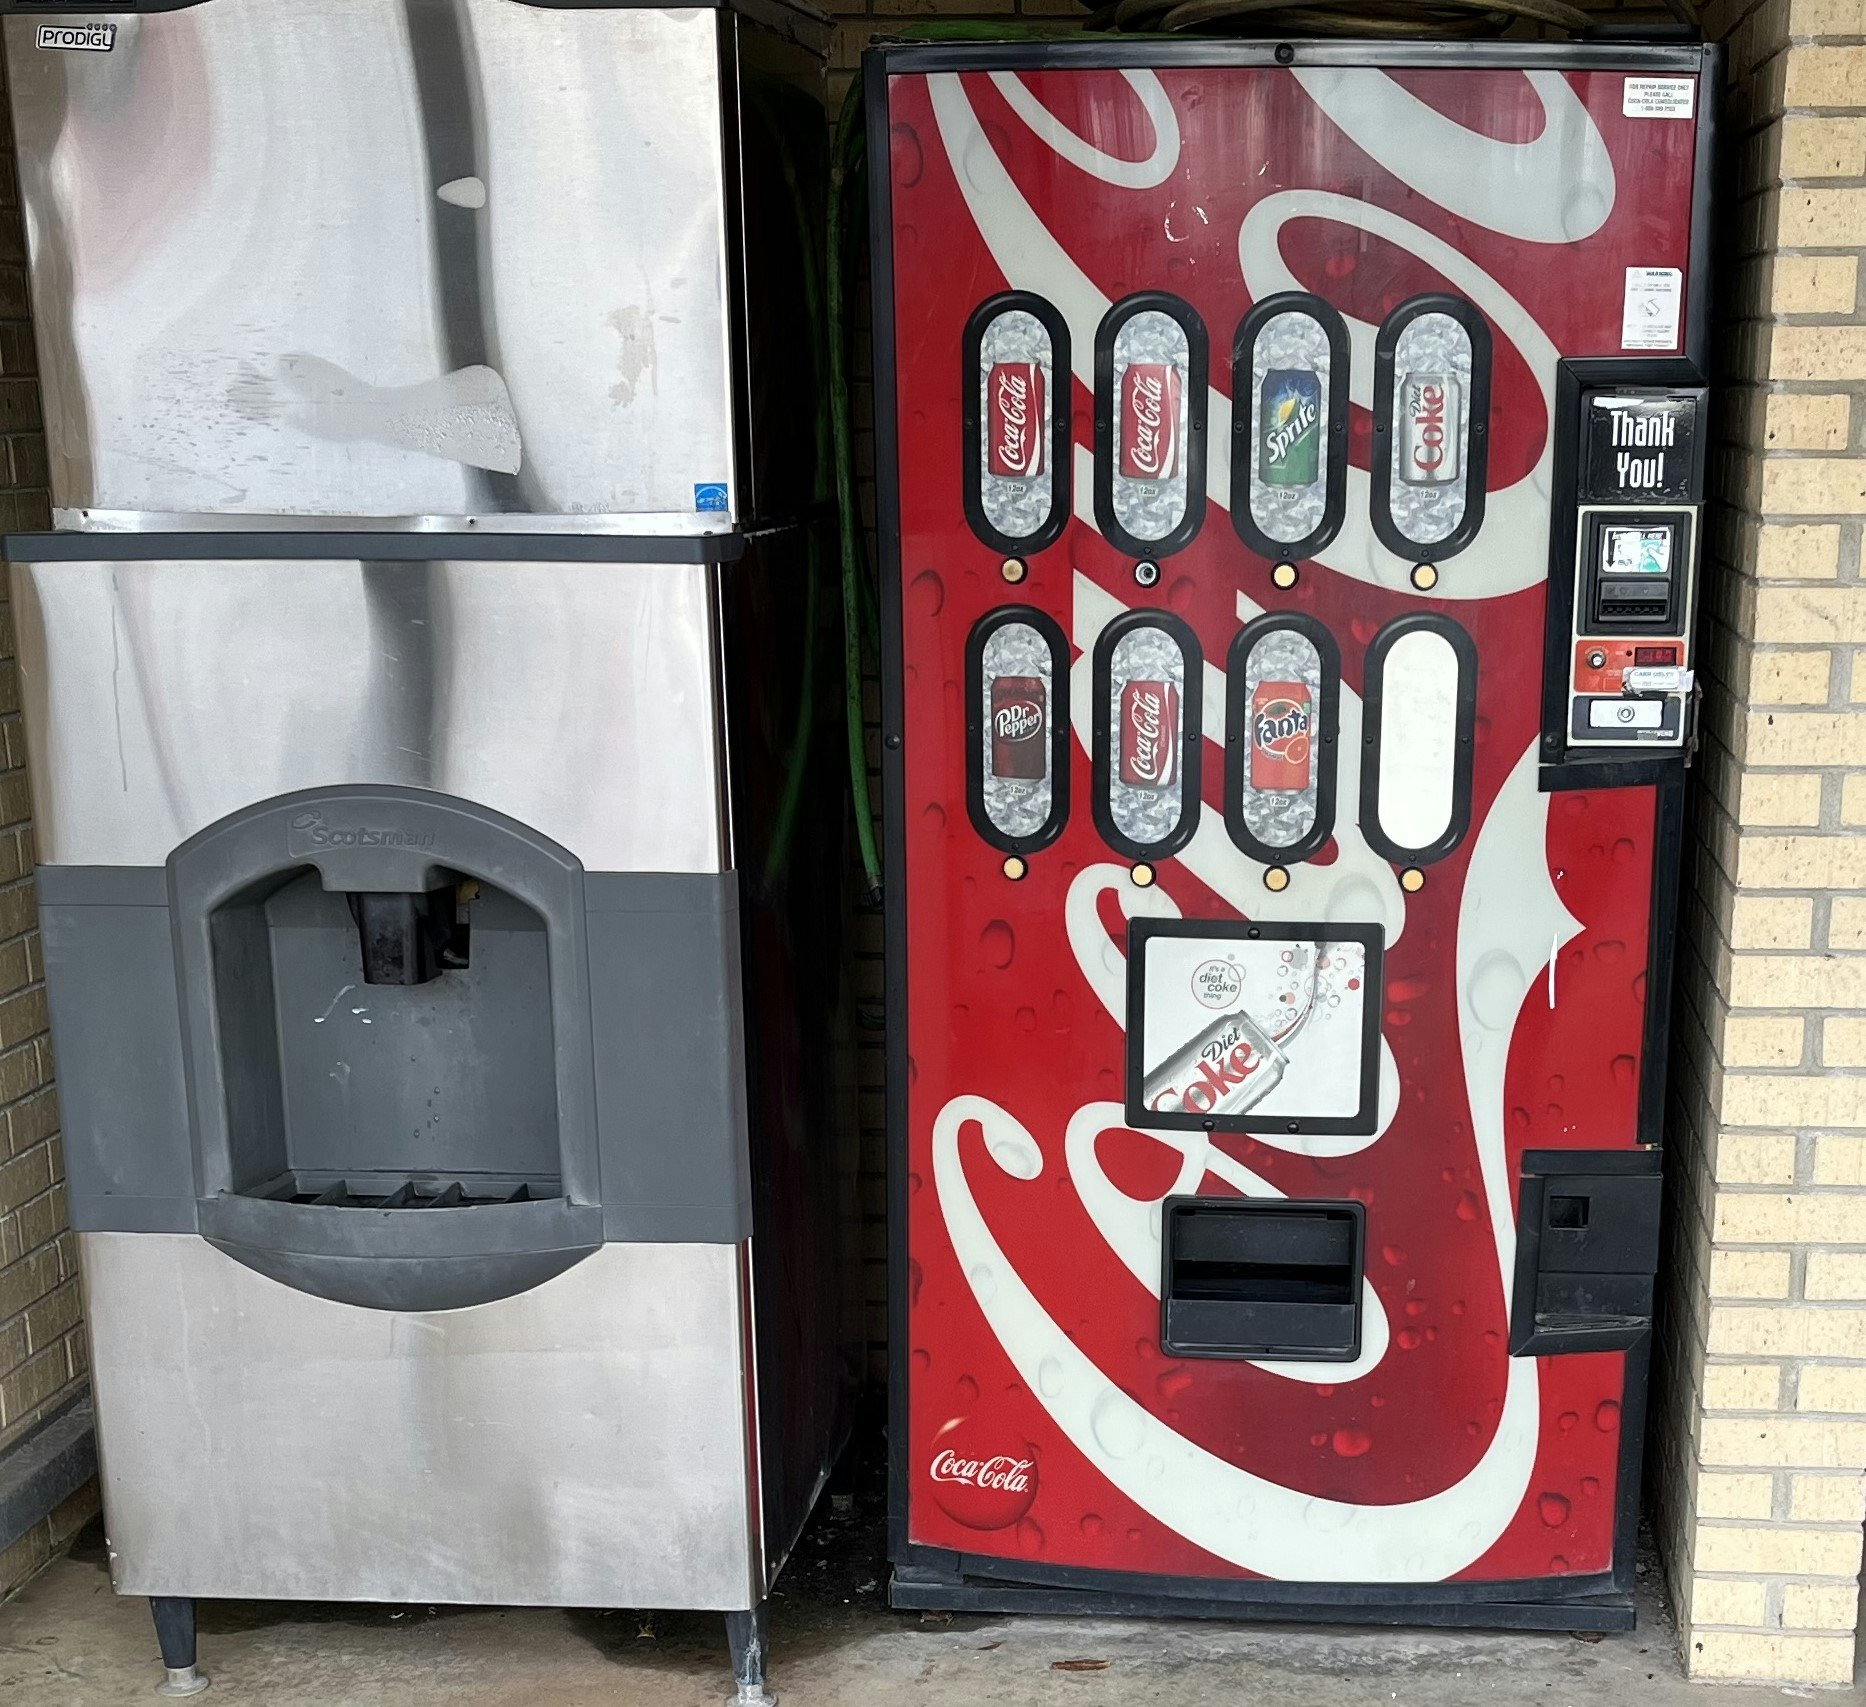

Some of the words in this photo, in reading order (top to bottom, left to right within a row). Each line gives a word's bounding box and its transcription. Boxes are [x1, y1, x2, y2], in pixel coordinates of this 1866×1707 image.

[998, 370, 1027, 471] Coca-Cola
[1131, 371, 1162, 473] Coca-Cola
[1266, 403, 1316, 463] Sprite
[1414, 385, 1444, 471] Coke
[1610, 411, 1675, 446] Thank
[1617, 452, 1664, 488] You!
[1000, 709, 1040, 737] Pepper
[1011, 705, 1029, 722] Dr
[1254, 708, 1308, 748] Fanta
[1130, 688, 1160, 780] Coca-Cola
[312, 827, 436, 847] Scotsman
[1199, 972, 1223, 983] diet
[1207, 981, 1237, 993] coke
[1202, 1027, 1241, 1062] Diet
[930, 1449, 1034, 1493] Coca-Cola
